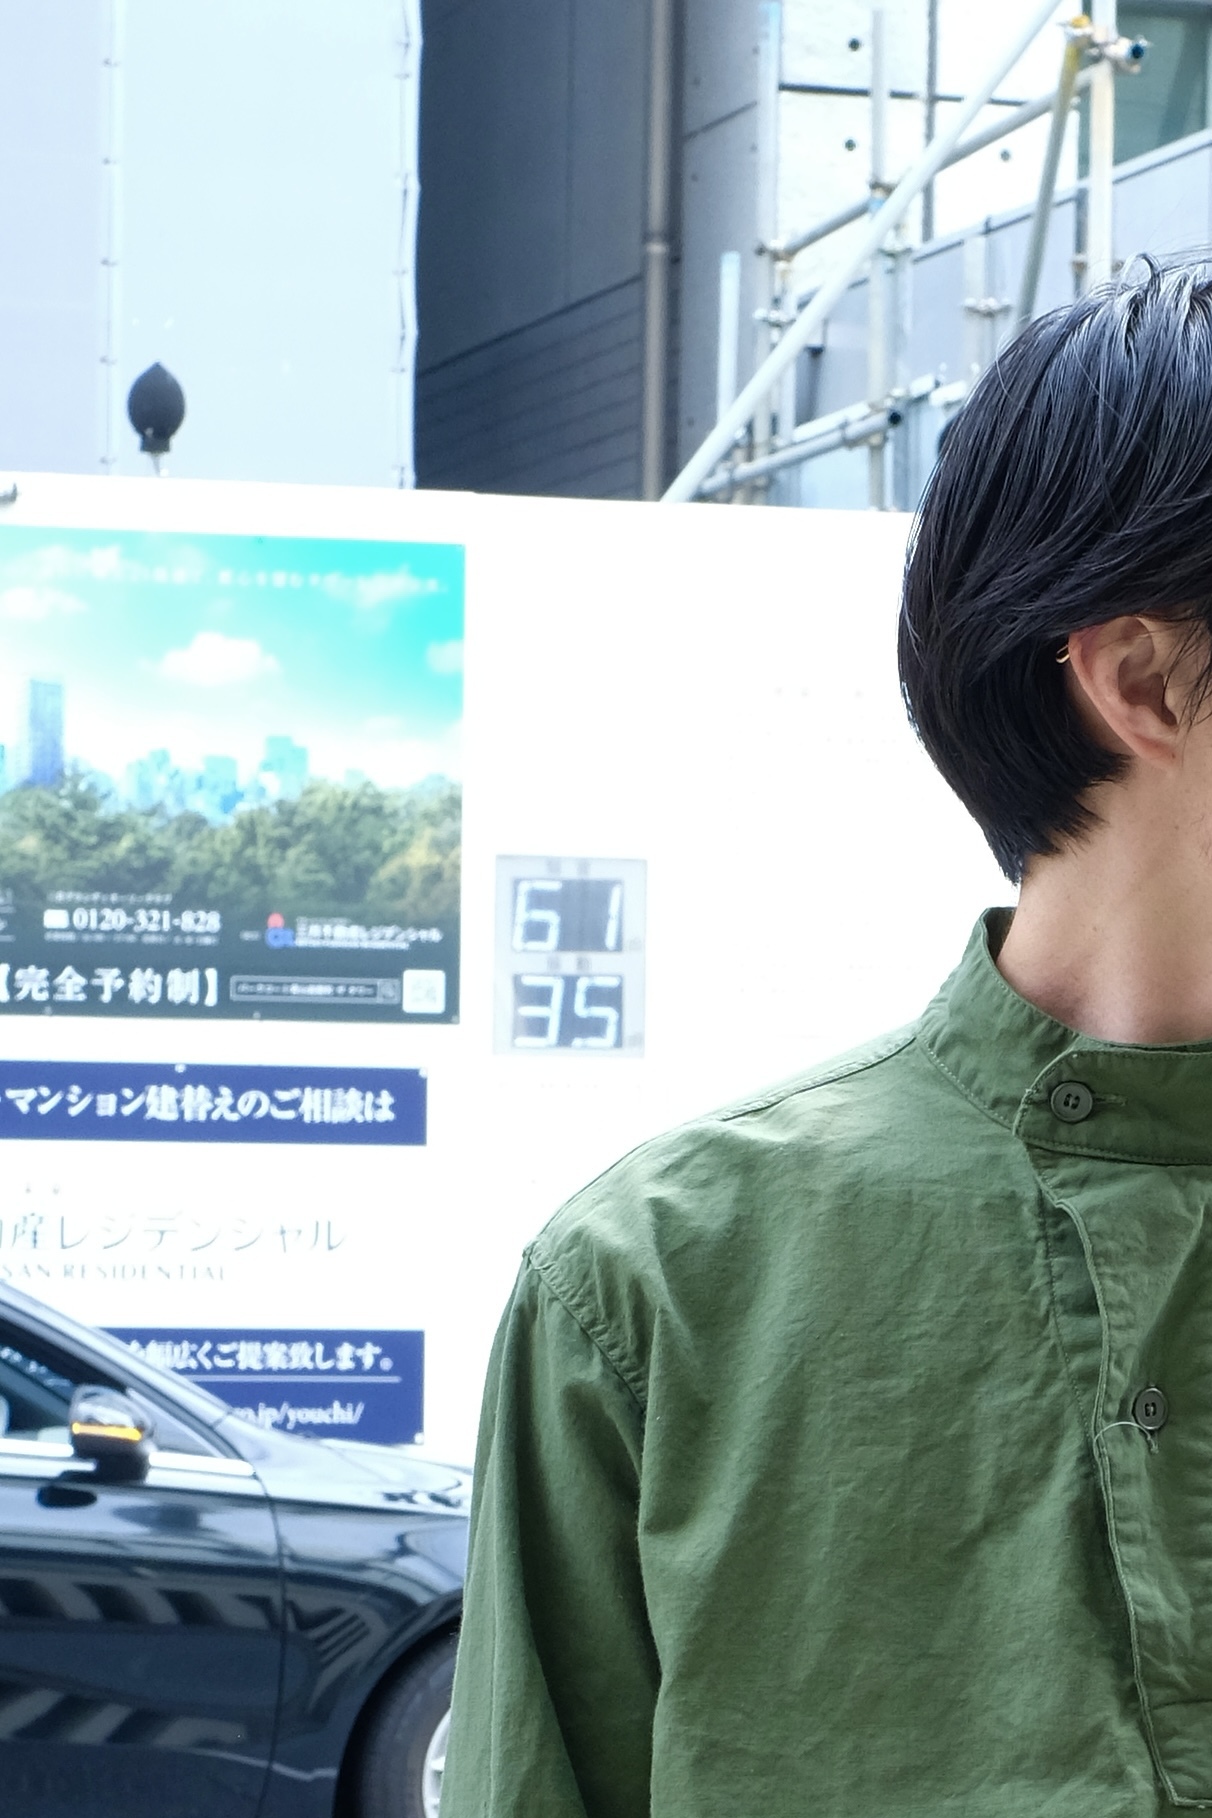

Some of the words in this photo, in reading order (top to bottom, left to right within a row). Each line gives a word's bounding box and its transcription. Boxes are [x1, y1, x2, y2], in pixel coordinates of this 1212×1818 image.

[73, 907, 221, 933] 0120-321-828
[511, 879, 622, 951] 61
[0, 963, 218, 1007] 【完全予約制】
[513, 975, 620, 1048] 35
[5, 1084, 396, 1123] マンション建替えのご相談は
[0, 1210, 348, 1253] 産レジデンシャル
